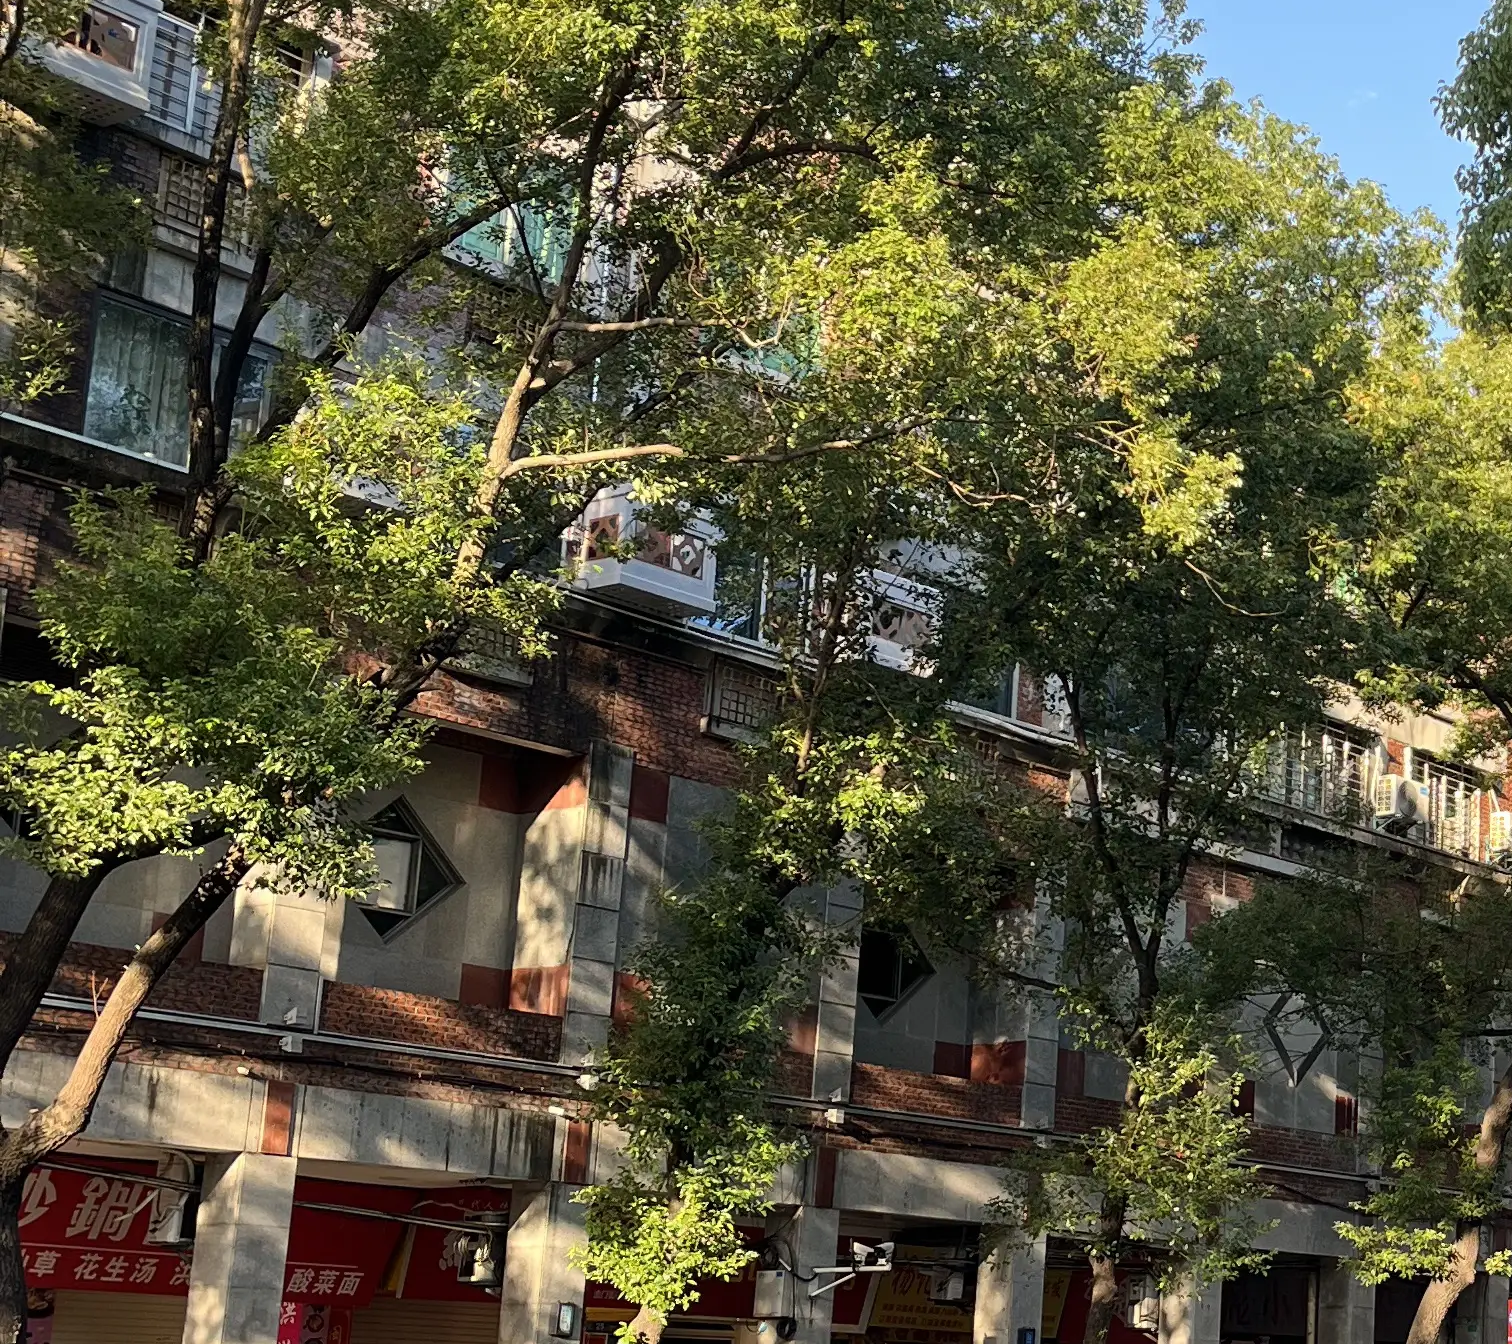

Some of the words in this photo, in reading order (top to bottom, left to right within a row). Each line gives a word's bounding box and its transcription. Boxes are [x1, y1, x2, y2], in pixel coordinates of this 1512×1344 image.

[74, 1252, 160, 1284] 花生汤
[286, 1267, 365, 1297] 酸菜面
